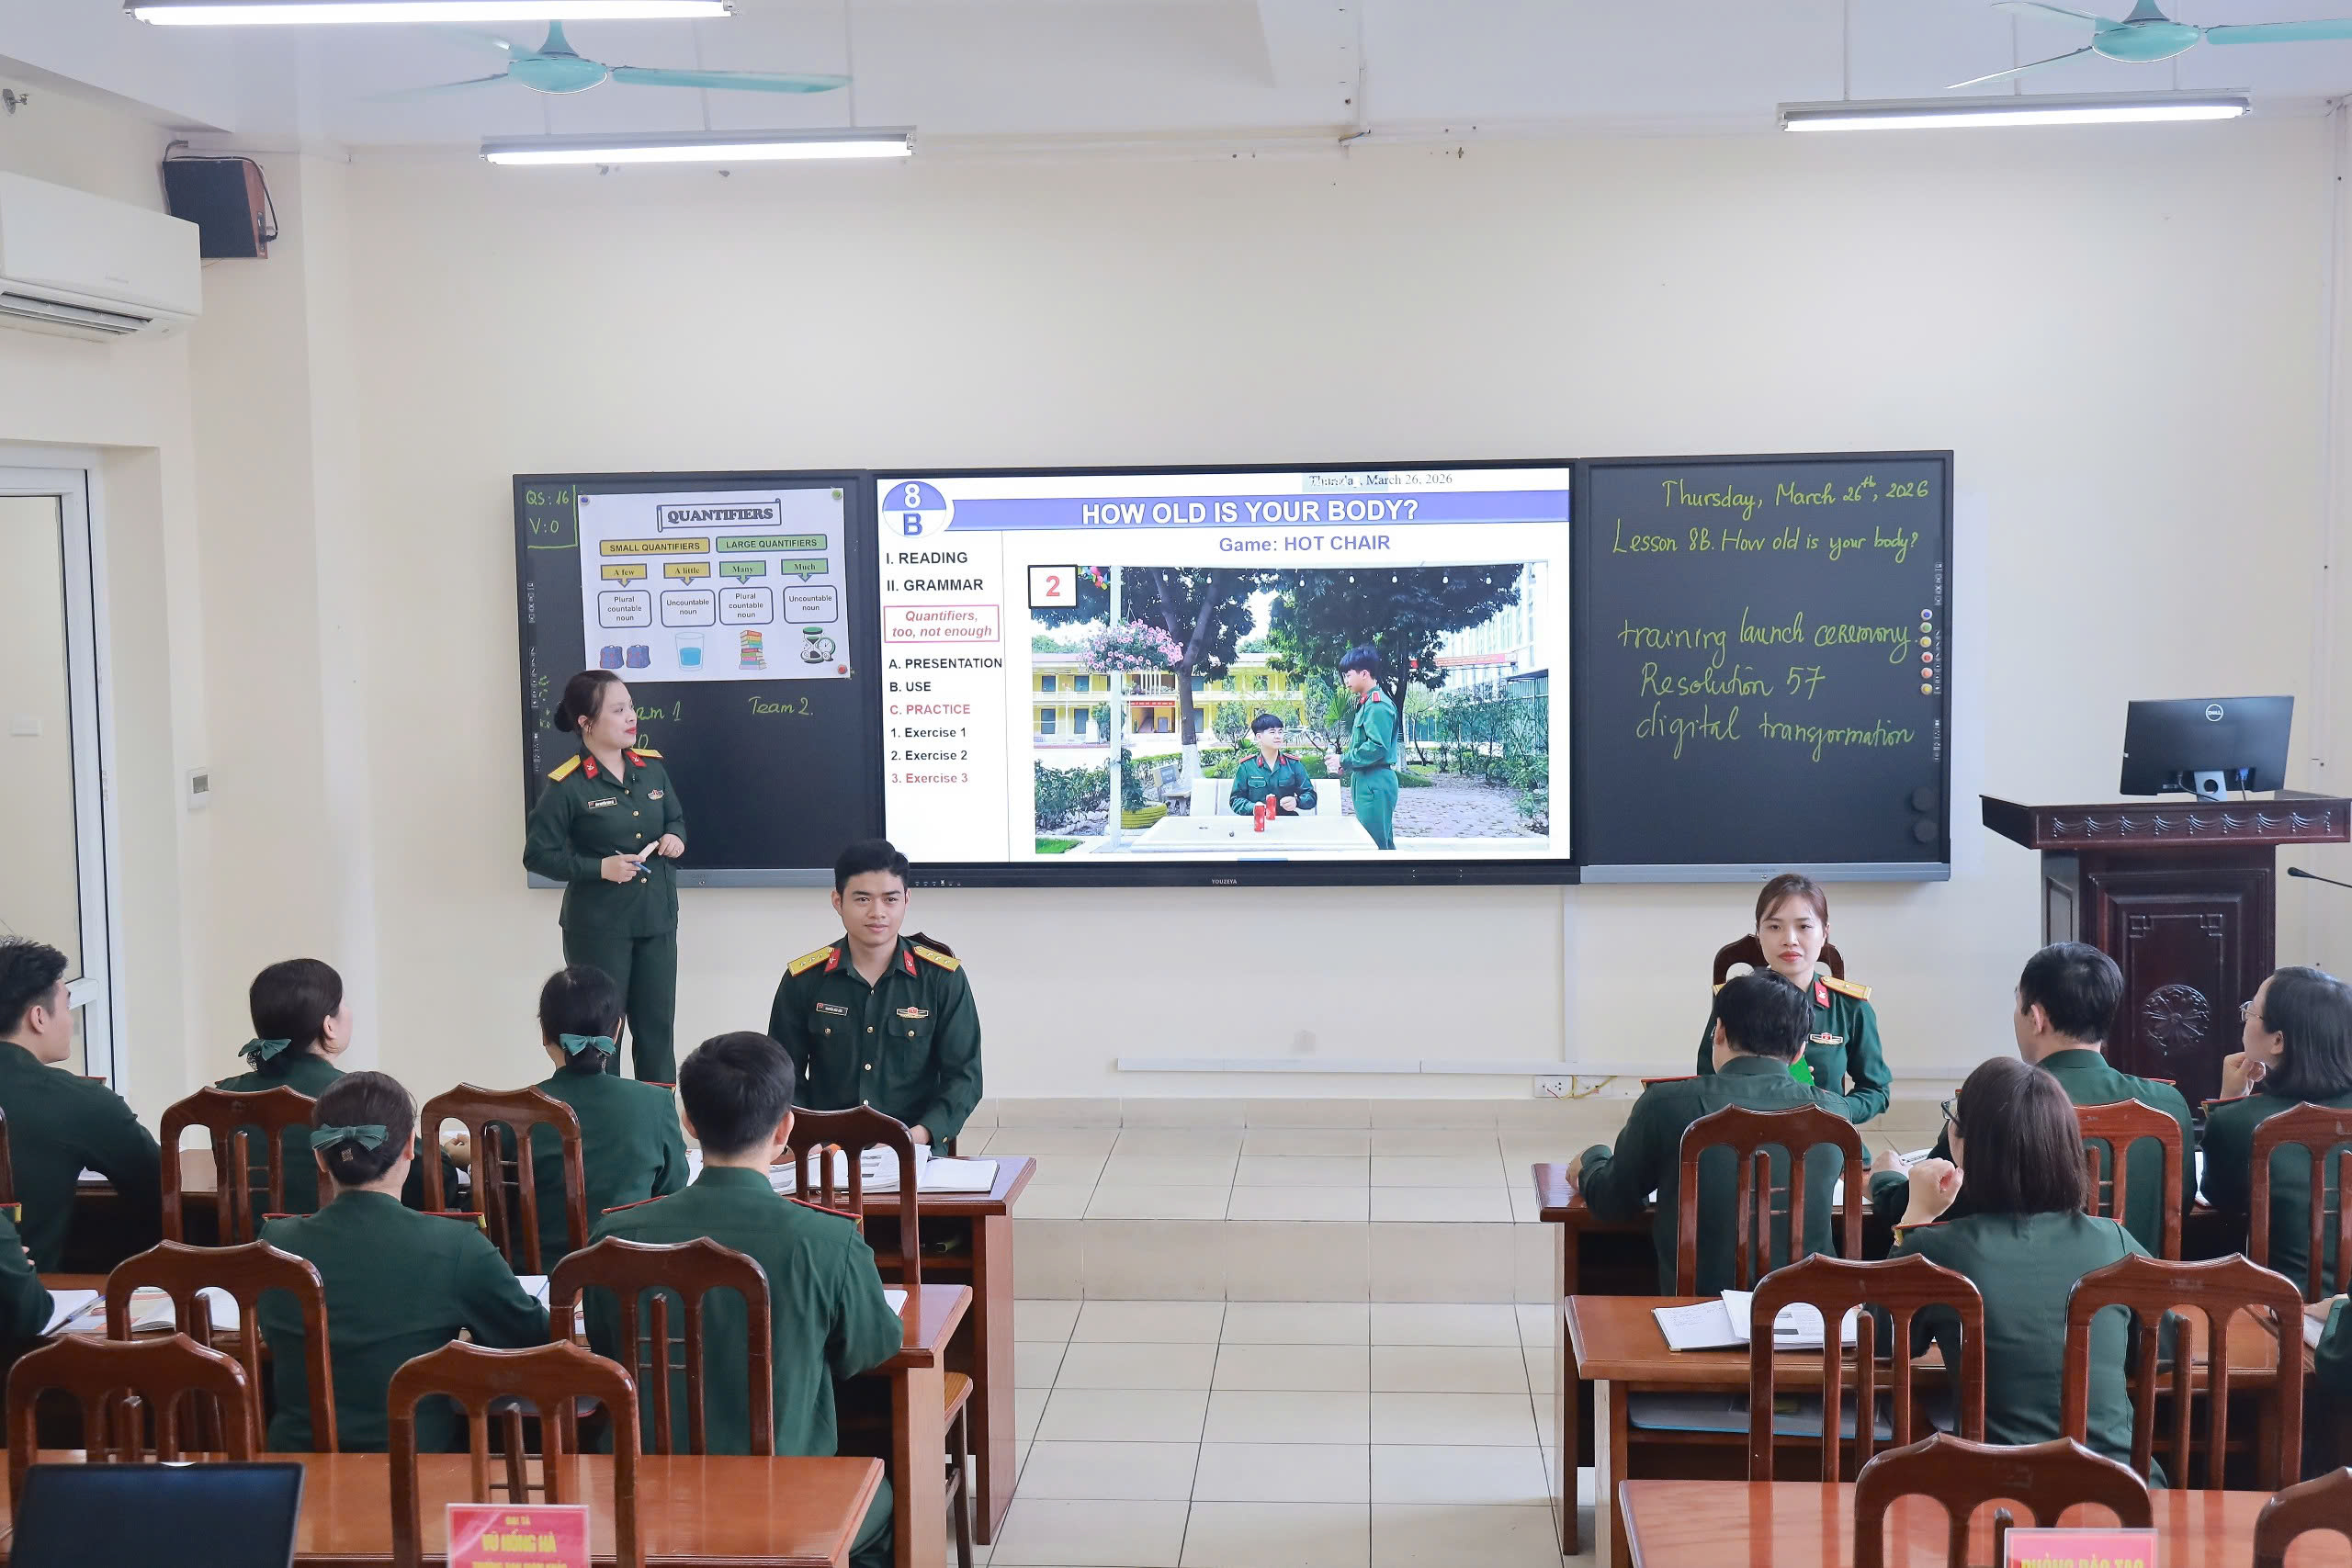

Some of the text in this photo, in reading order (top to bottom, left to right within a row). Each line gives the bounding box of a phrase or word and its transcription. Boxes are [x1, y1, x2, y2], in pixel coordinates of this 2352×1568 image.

[1366, 474, 1401, 486] March
[1405, 474, 1422, 485] 26,
[1426, 473, 1452, 484] 2026
[904, 483, 922, 508] 8
[1662, 479, 1763, 521] Thursday,
[1776, 481, 1836, 506] March
[1885, 479, 1928, 498] 2026
[667, 508, 773, 525] QUANTIFIERS
[1081, 499, 1419, 525] HOW OLD IS YOUR BODY?
[903, 513, 922, 536] B
[610, 542, 700, 552] SMALL QUANTIFIERS
[726, 538, 817, 549] LARGE QUANTIFIERS
[1219, 535, 1391, 552] Game: HOT CHAIR
[1612, 518, 1678, 553] Lesson
[1721, 528, 1766, 551] How
[1772, 526, 1801, 550] old
[1806, 534, 1819, 549] is
[1829, 536, 1867, 561] your
[1873, 525, 1918, 563] body?
[886, 552, 968, 564] I. READING
[732, 566, 754, 574] Many
[794, 562, 816, 570] Much
[887, 579, 984, 592] II. GRAMMAR
[1046, 575, 1060, 597] 2
[788, 594, 832, 603] Uncountable
[905, 610, 978, 623] Quantifiers,
[892, 626, 992, 638] too, not enough
[1617, 619, 1726, 669] training
[1740, 606, 1804, 645] launch
[888, 658, 1002, 670] A. PRESENTATION
[889, 682, 932, 692] B. USE
[1641, 661, 1826, 701] Resolution 57
[673, 701, 682, 721] 1
[749, 696, 795, 716] Team
[889, 704, 970, 715] C. PRACTICE
[890, 727, 966, 738] 1. Exercise 1
[1636, 700, 1741, 760] digital
[890, 750, 967, 761] 2. Exercise 2
[891, 773, 968, 784] 3. Exercise 3
